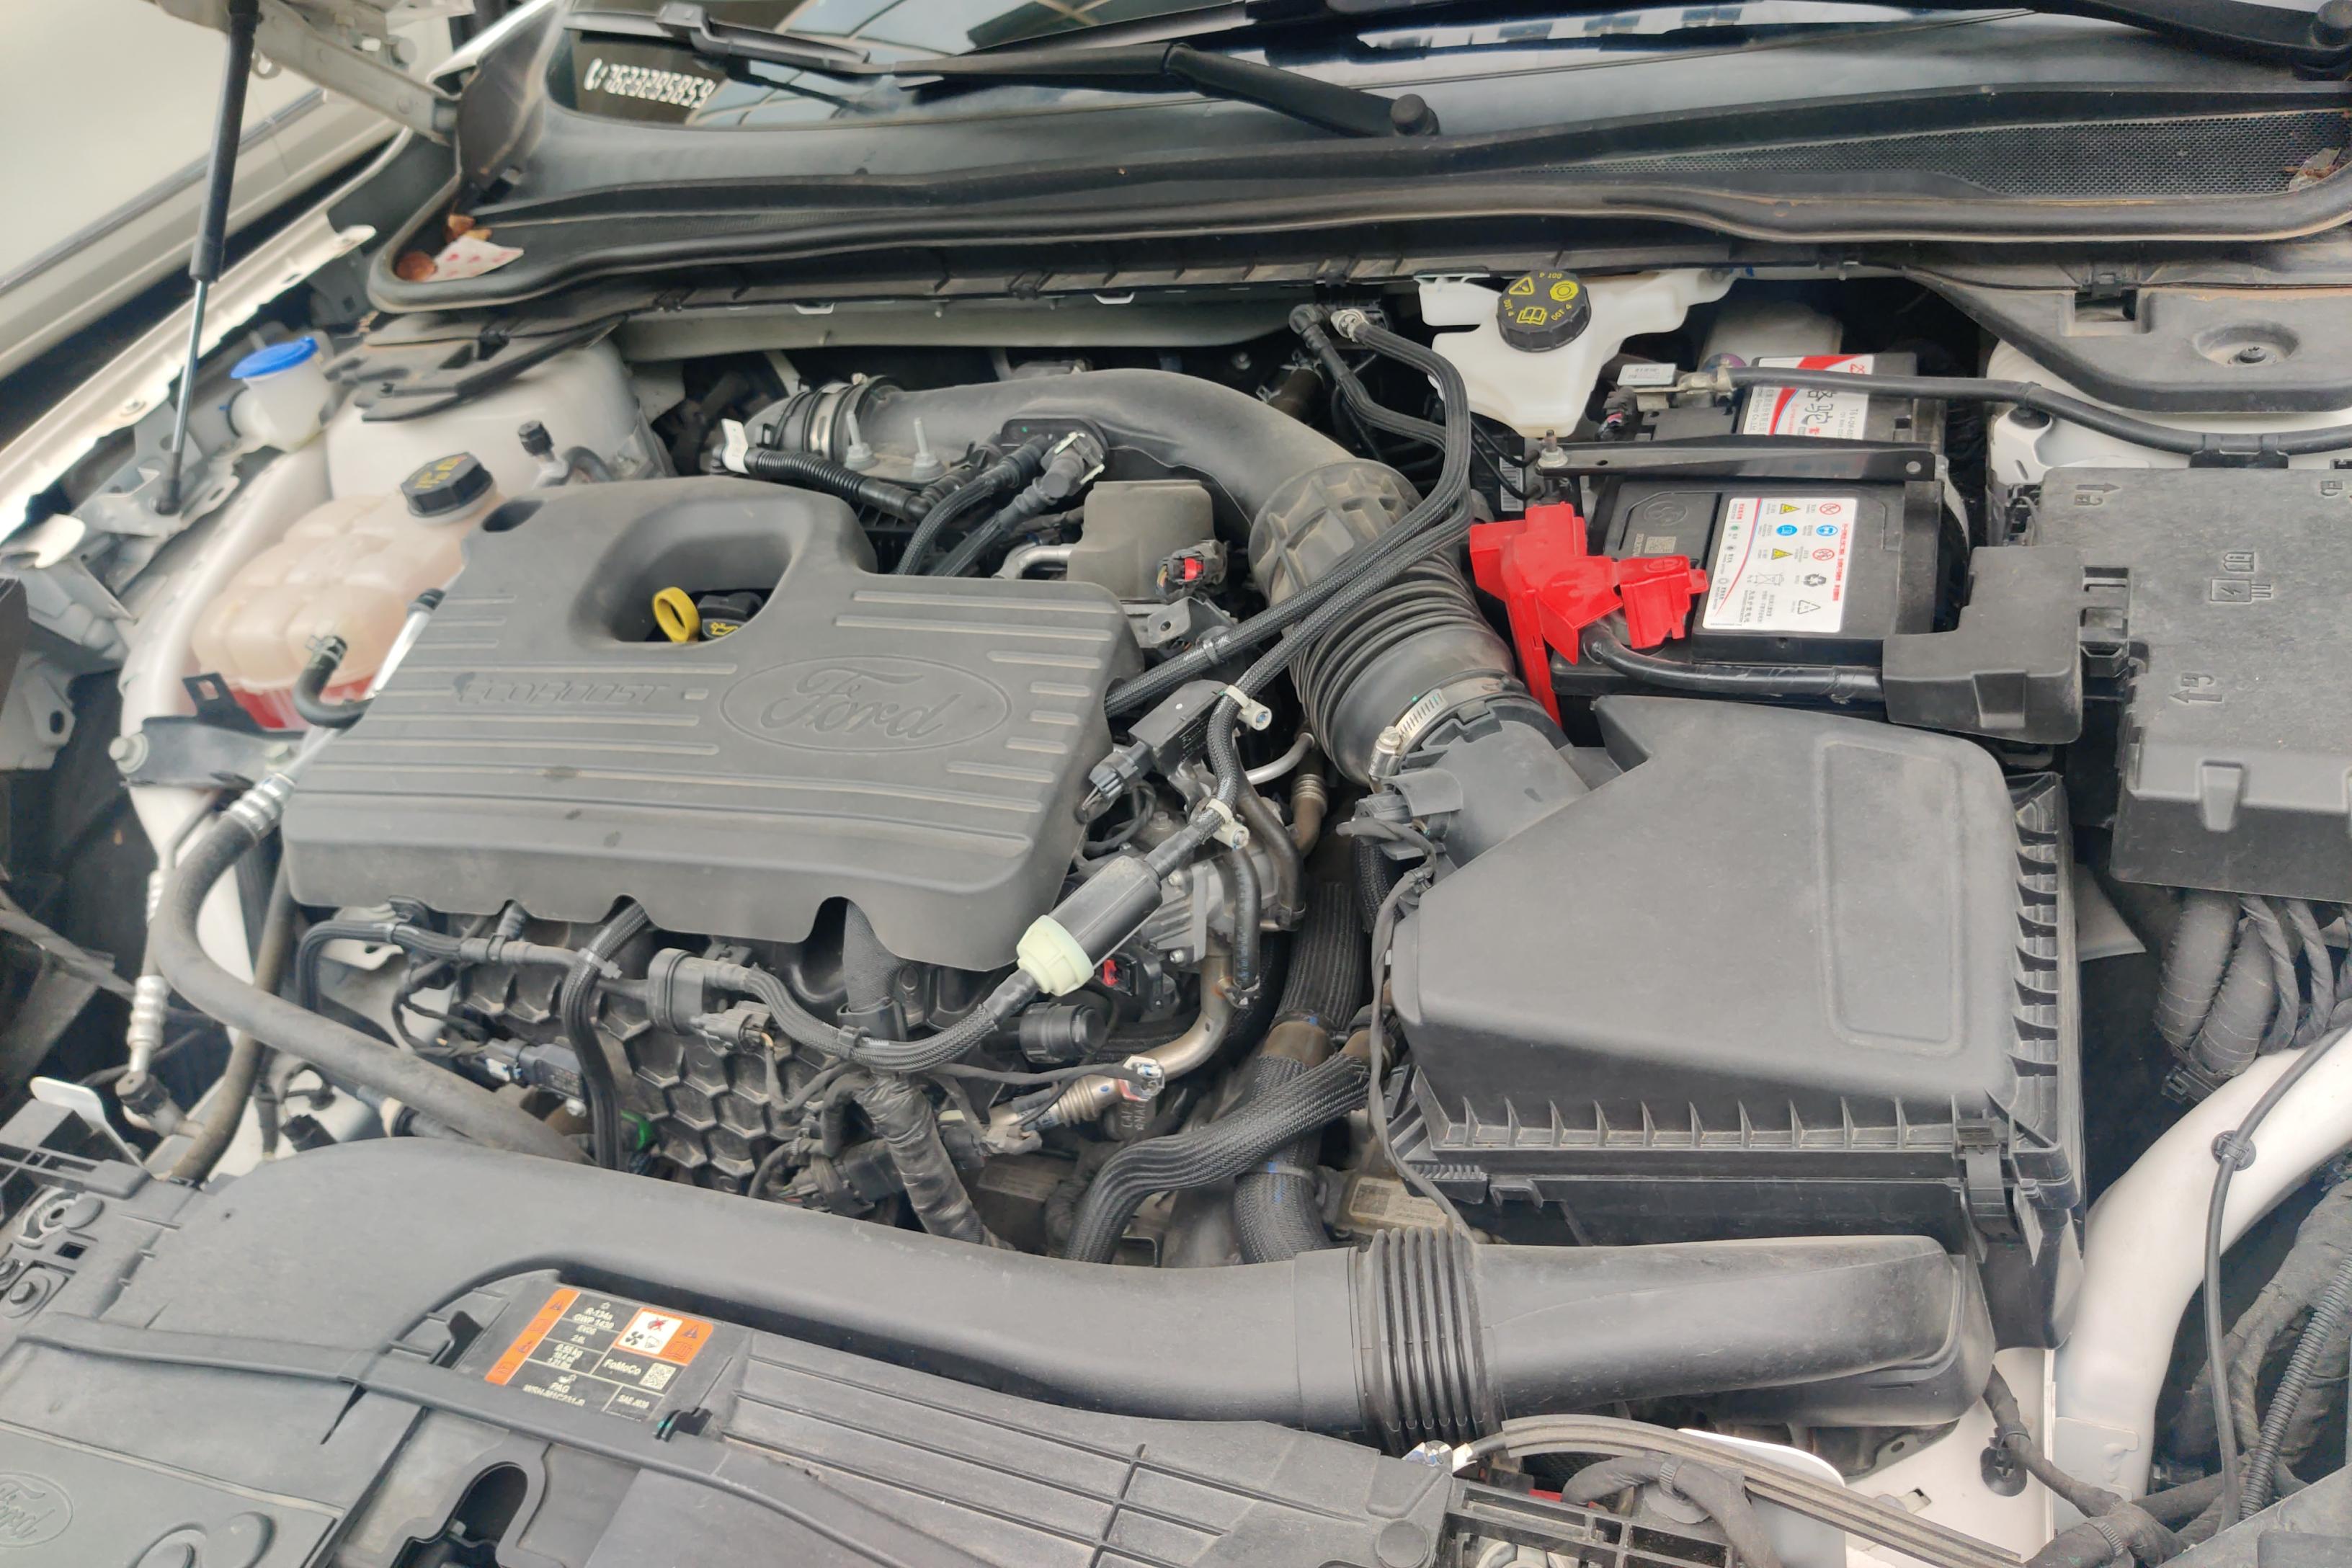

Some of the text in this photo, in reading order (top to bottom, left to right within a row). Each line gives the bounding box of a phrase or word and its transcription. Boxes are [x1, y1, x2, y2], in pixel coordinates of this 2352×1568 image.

[760, 667, 962, 740] Ford
[602, 1358, 642, 1376] FoMoCo
[548, 1382, 570, 1394] PAG
